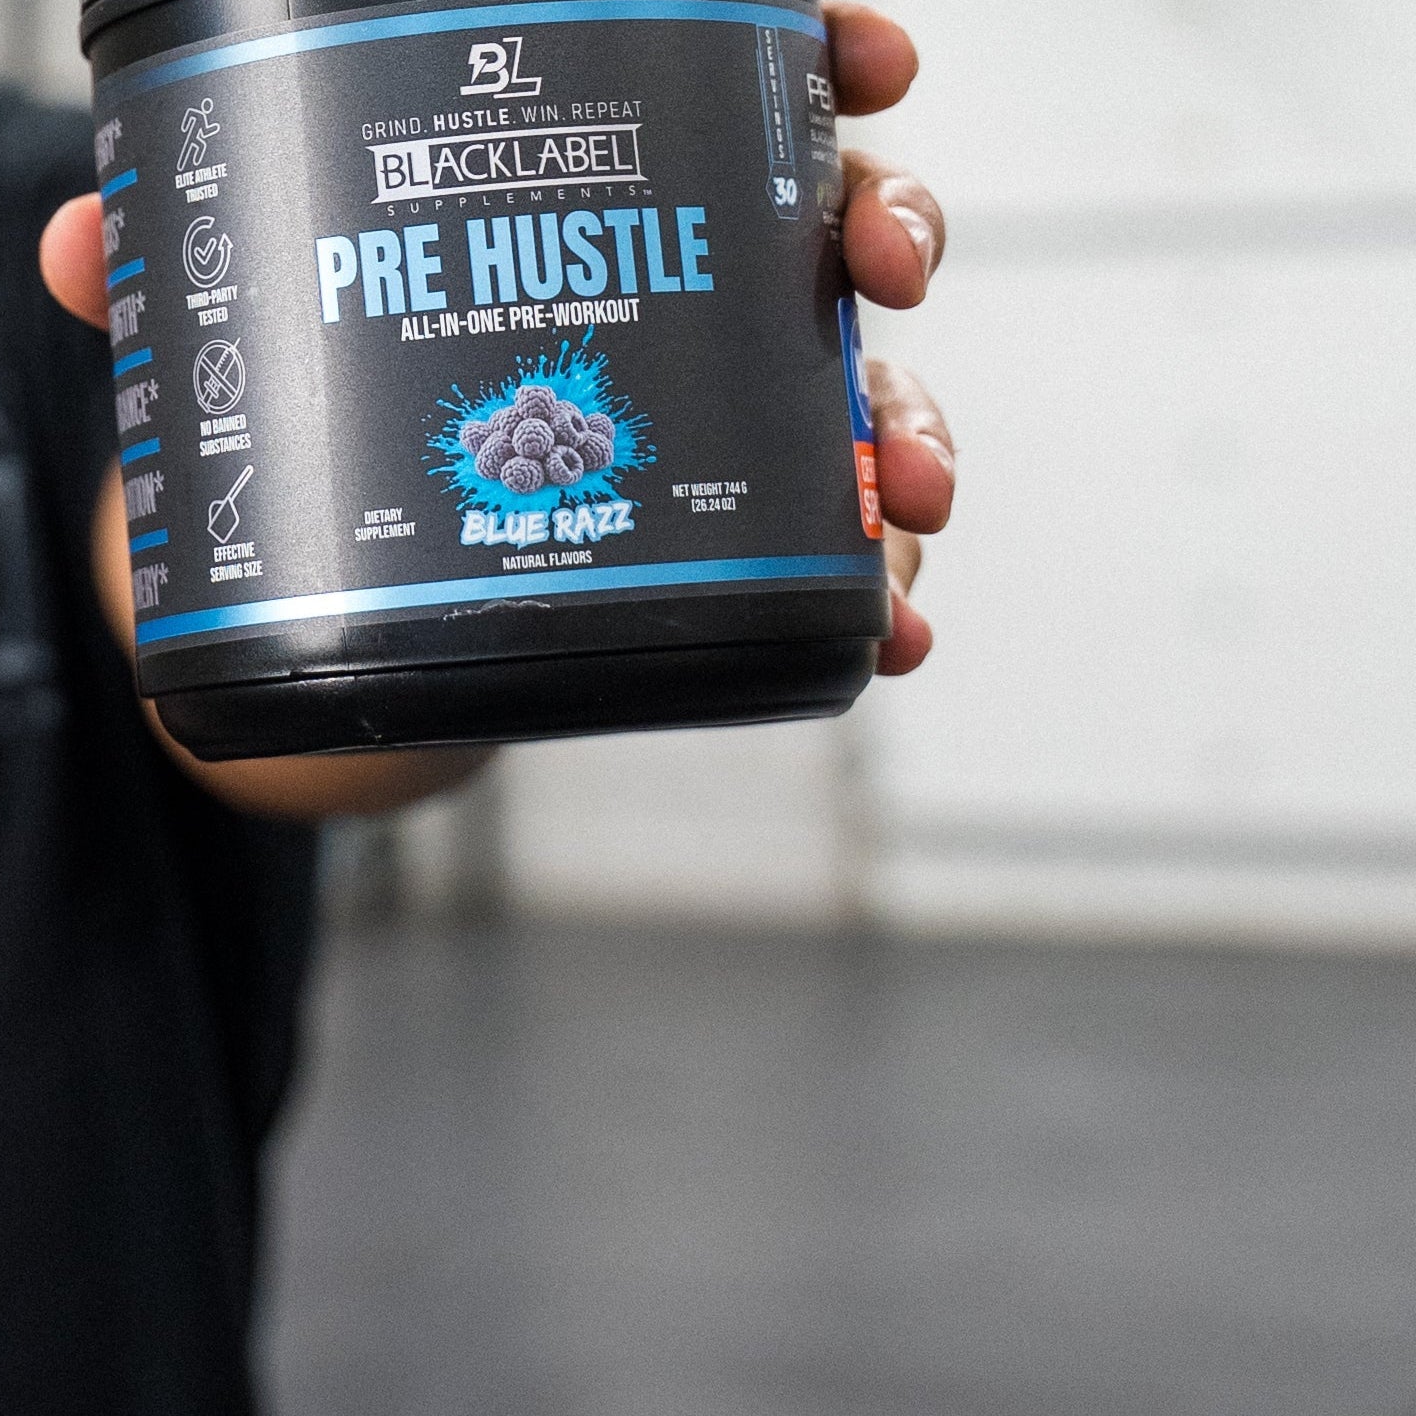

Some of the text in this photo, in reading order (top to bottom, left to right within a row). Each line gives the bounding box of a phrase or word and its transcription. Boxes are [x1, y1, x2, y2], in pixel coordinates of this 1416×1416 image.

[361, 100, 644, 142] GRIND. HUSTLE. WIN. REPEAT
[379, 134, 635, 191] BLACKLABEL
[175, 162, 228, 190] ELITE ATHLETE
[185, 182, 219, 204] TRUSTED
[772, 176, 799, 208] 30
[315, 205, 715, 325] PRE HUSTLE
[186, 285, 239, 311] THIRD-PARTY
[197, 306, 229, 327] TESTED
[400, 297, 641, 342] ALL-IN-ONE PRE-WORKOUT
[199, 413, 248, 438] NO BANNED
[199, 432, 252, 458] SUBSTANCES
[672, 483, 690, 498] NET
[690, 482, 723, 497] WEIGHT
[723, 481, 741, 495] 744
[364, 507, 404, 525] DIETARY
[461, 499, 636, 551] BLUE RAZZ
[354, 521, 417, 542] SUPPLEMENT
[213, 541, 256, 564] EFFECTIVE
[502, 549, 593, 571] NATURAL FLAVORS
[209, 560, 264, 584] SERVING SIZE
